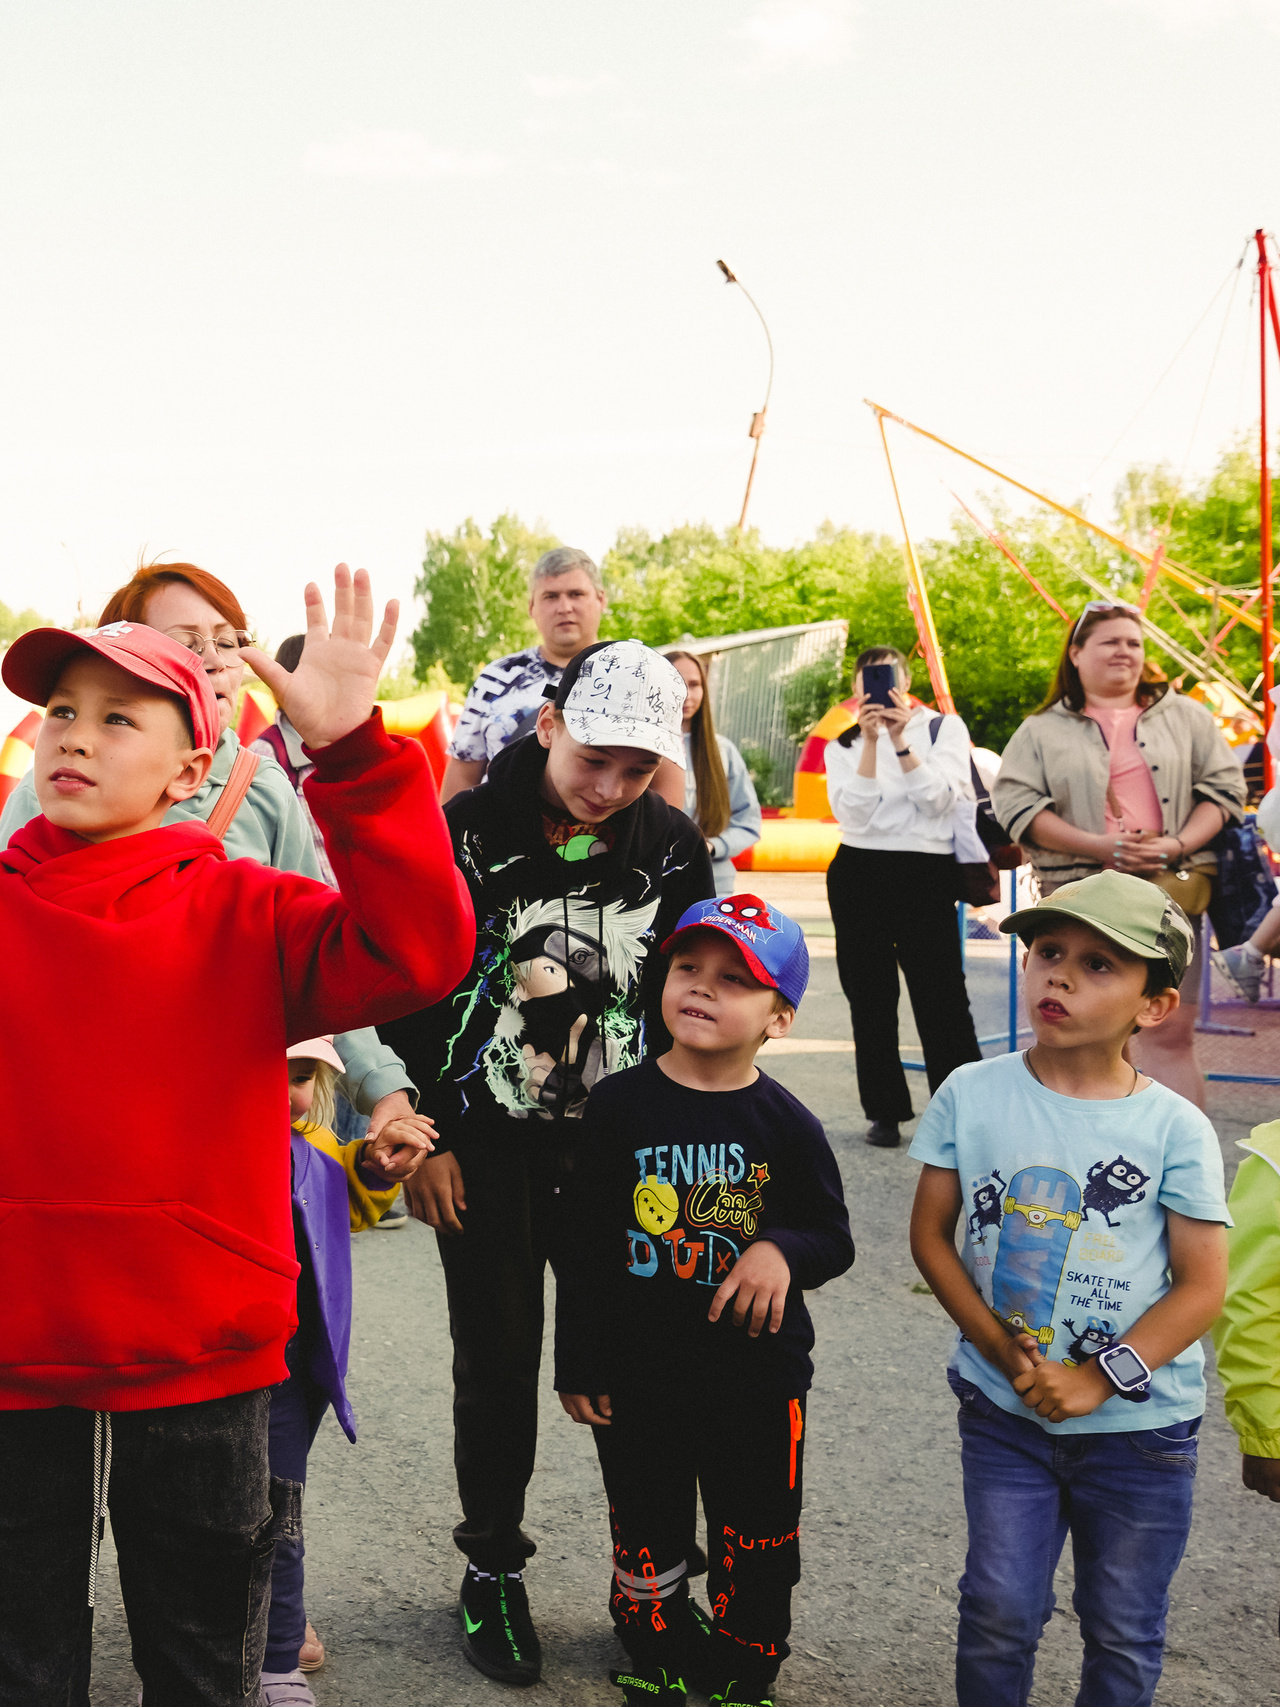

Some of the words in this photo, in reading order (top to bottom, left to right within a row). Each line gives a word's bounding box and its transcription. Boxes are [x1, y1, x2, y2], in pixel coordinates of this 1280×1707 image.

[700, 915, 757, 944] SPIDER-MAN
[634, 1143, 745, 1186] TENNIS
[1084, 1232, 1116, 1248] FREE
[1078, 1247, 1124, 1263] BOARD
[1066, 1270, 1105, 1287] SKATE
[1107, 1278, 1132, 1292] TIME
[1090, 1287, 1111, 1300] ALL
[1070, 1294, 1093, 1309] THE
[1097, 1300, 1123, 1312] TIME
